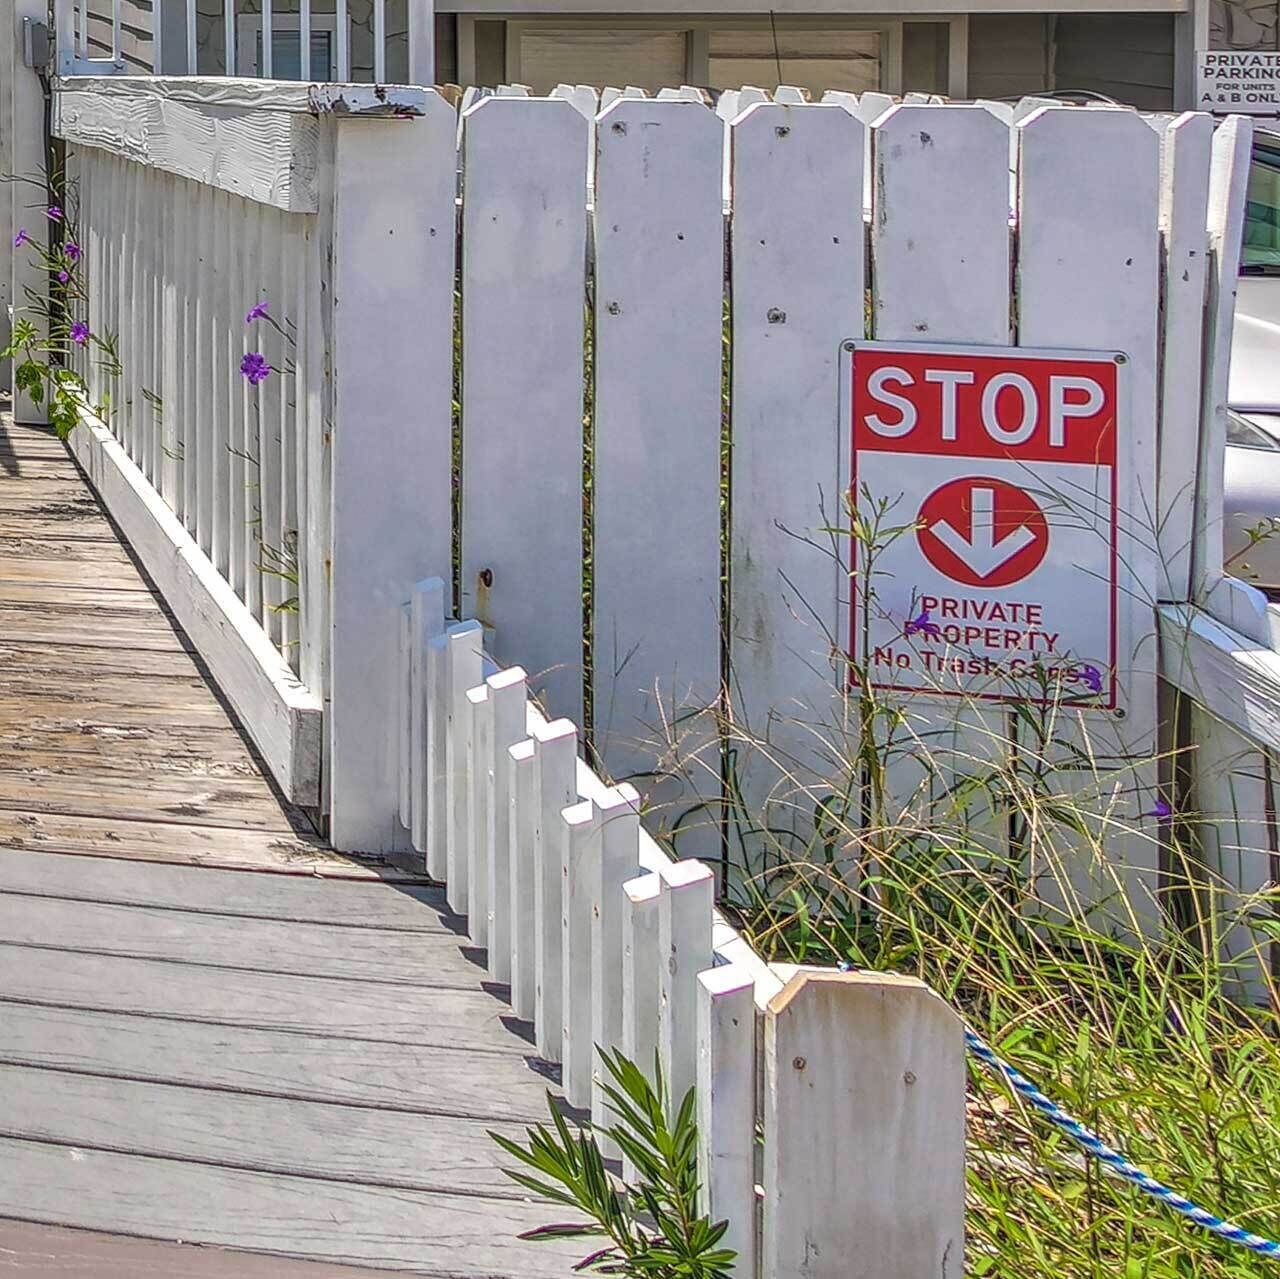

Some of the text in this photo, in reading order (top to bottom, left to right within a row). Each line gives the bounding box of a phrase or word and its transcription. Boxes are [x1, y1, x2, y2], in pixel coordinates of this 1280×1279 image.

[1202, 93, 1280, 103] A & B ONL
[1242, 83, 1276, 91] UNITS
[863, 366, 1106, 447] STOP
[922, 596, 1042, 625] PRIVATE
[874, 646, 910, 669] No
